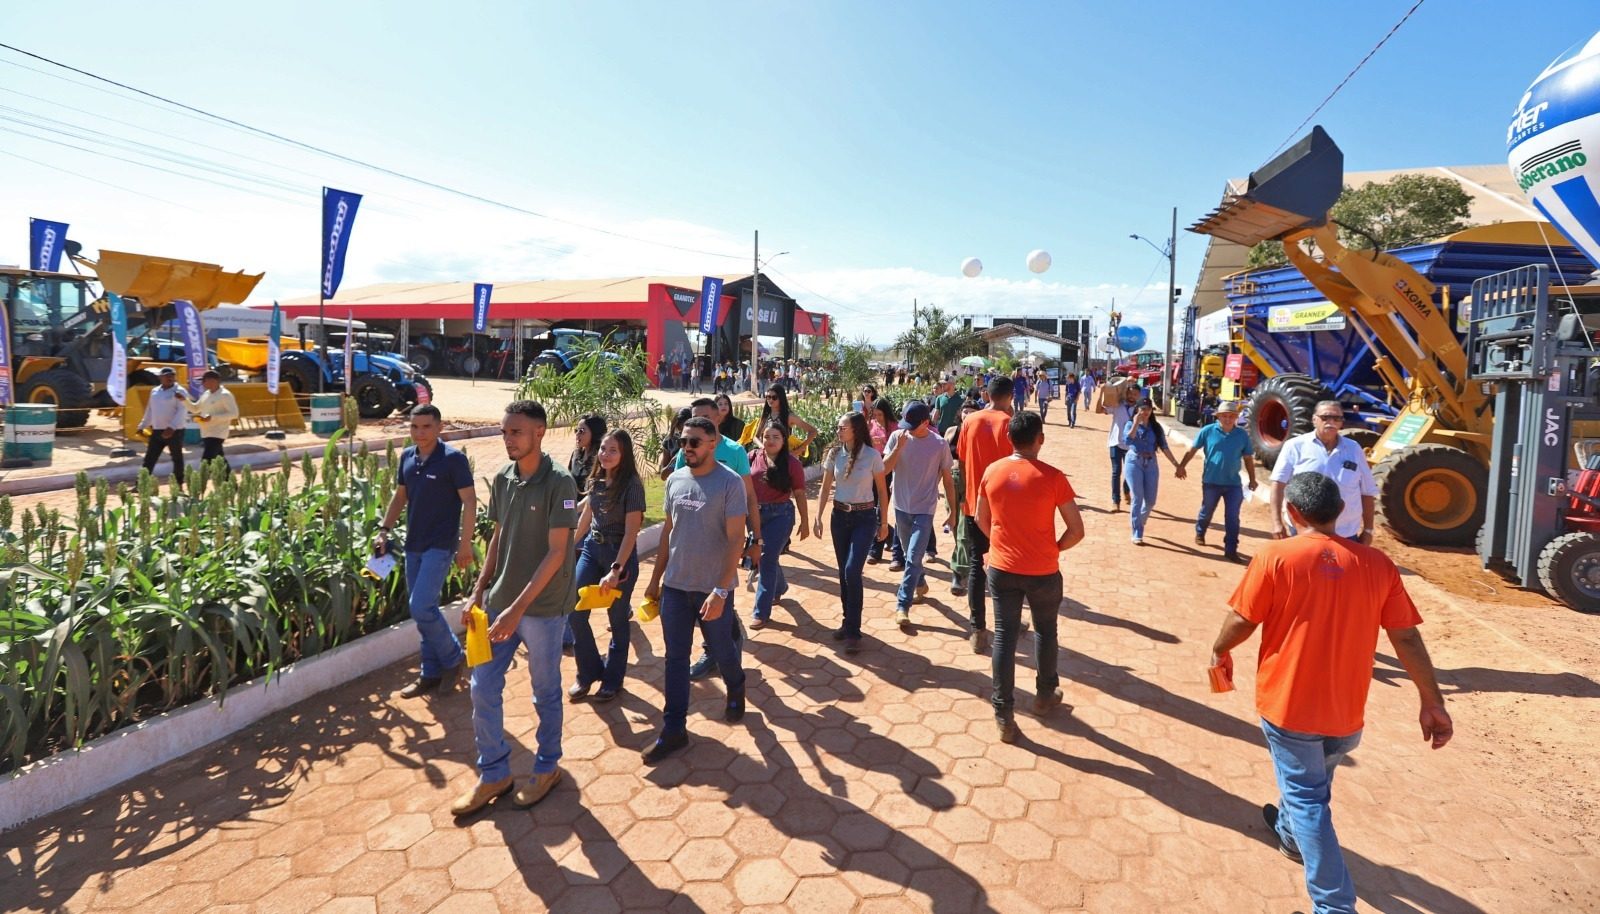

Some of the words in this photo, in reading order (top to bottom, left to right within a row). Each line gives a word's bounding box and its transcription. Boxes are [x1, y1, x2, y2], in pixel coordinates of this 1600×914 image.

[746, 306, 769, 323] CSE
[1294, 310, 1327, 320] GRANNER
[1403, 289, 1432, 318] XGMA
[183, 306, 201, 351] XCMG
[1544, 408, 1560, 446] JAC
